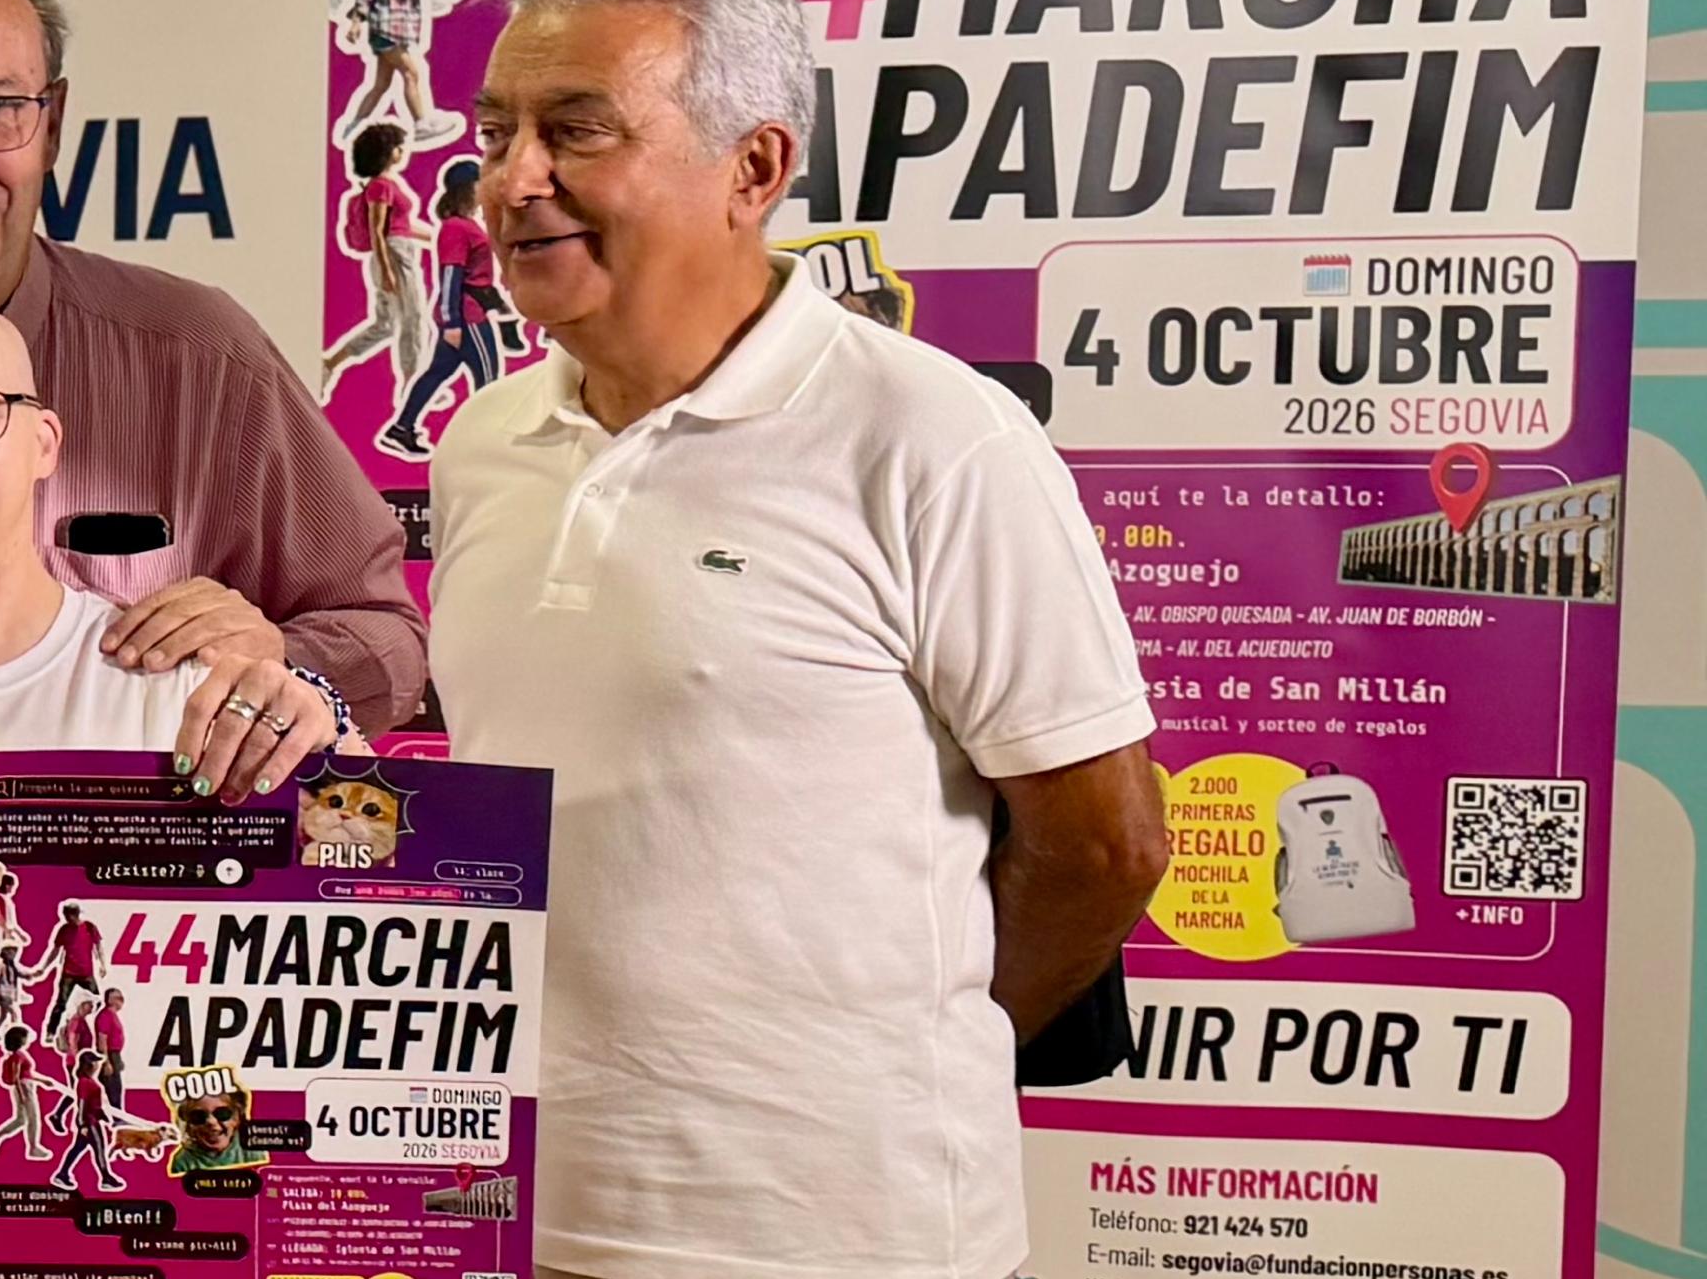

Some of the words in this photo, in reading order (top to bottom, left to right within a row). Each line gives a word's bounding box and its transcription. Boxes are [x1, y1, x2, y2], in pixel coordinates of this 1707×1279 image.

[1367, 256, 1554, 295] DOMINGO
[1064, 308, 1119, 386] 4
[1147, 304, 1551, 386] OCTUBRE
[1284, 397, 1375, 435] 2026
[1389, 397, 1549, 436] SEGOVIA
[1103, 486, 1160, 509] aquí
[1179, 488, 1204, 505] te
[1223, 486, 1249, 505] la
[1265, 486, 1384, 506] detallo:
[1133, 606, 1156, 623] AV.
[1161, 606, 1217, 624] OBISPO
[1221, 606, 1292, 625] QUESADA
[1308, 607, 1332, 624] AV.
[1336, 607, 1382, 625] JUAN
[1387, 606, 1409, 627] DE
[1412, 603, 1483, 628] BORBÓN
[1176, 640, 1199, 657] AV.
[1203, 640, 1233, 657] DEL
[1238, 640, 1333, 658] ACUEDUCTO
[1219, 676, 1250, 698] de
[1270, 676, 1320, 699] San
[1338, 676, 1446, 704] Millán
[1161, 715, 1229, 731] musical
[1238, 719, 1247, 733] y
[1257, 719, 1316, 732] sorteo
[1325, 716, 1345, 733] de
[1355, 716, 1427, 737] regalos
[1189, 776, 1238, 795] 2.000
[1170, 803, 1256, 821] PRIMERAS
[317, 842, 374, 869] PLIS
[1164, 829, 1265, 857] REGALO
[1172, 865, 1249, 885] MOCHILA
[1191, 888, 1210, 904] DE
[1213, 888, 1229, 905] LA
[1174, 910, 1245, 929] MARCHA
[1456, 905, 1524, 926] +INFO
[149, 994, 518, 1074] APADEFIM
[1257, 1007, 1420, 1088] POR
[1452, 1015, 1527, 1095] TI
[166, 1068, 238, 1102] COOL
[316, 1105, 336, 1136] 4
[349, 1106, 500, 1140] OCTUBRE
[1090, 1157, 1155, 1195] MÁS
[1168, 1164, 1378, 1203] INFORMACIÓN
[1089, 1207, 1178, 1235] Teléfono:
[1183, 1215, 1218, 1236] 921
[1224, 1217, 1264, 1237] 424
[1271, 1218, 1308, 1238] 570
[1088, 1244, 1155, 1269] E-mail:
